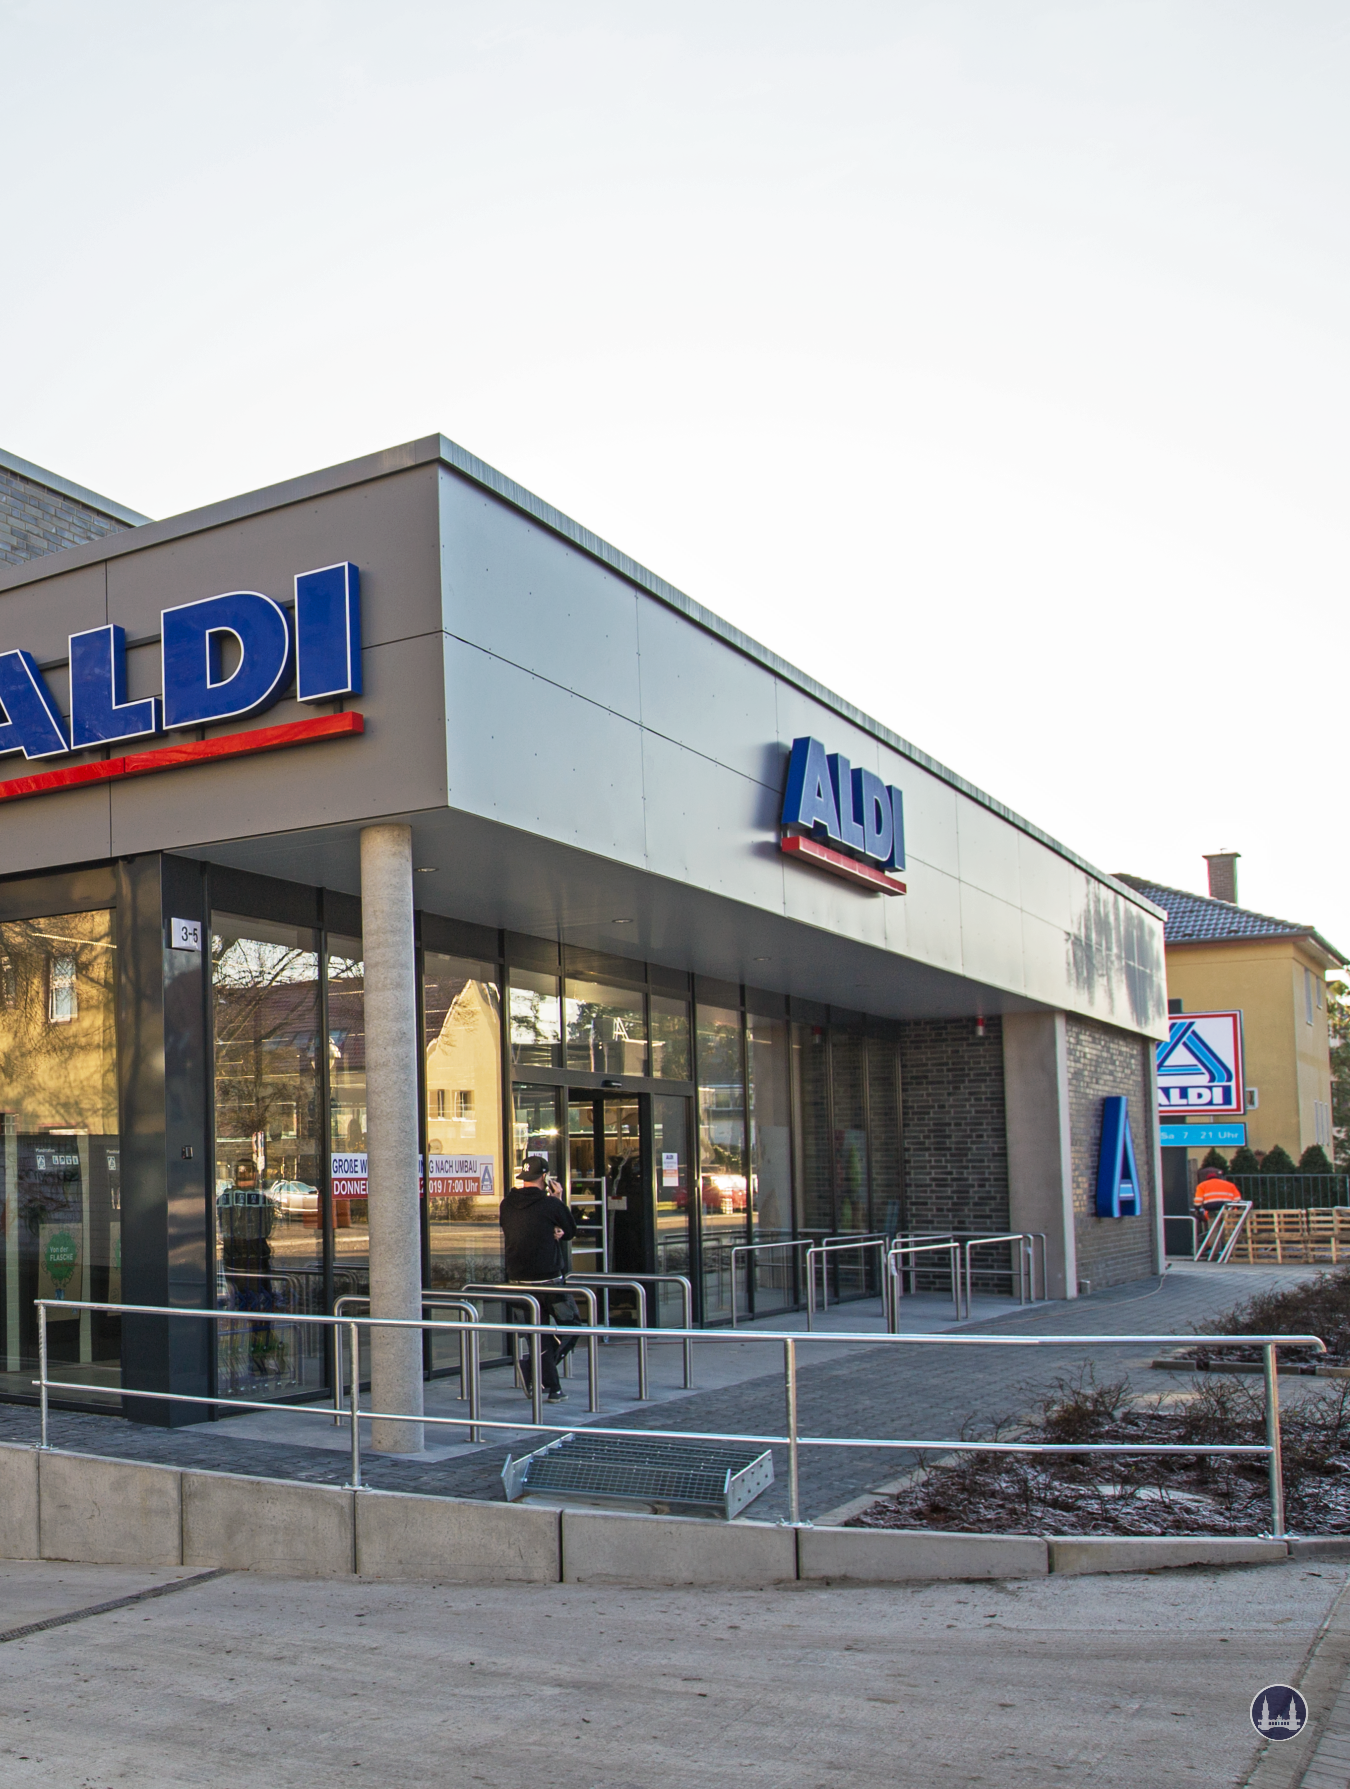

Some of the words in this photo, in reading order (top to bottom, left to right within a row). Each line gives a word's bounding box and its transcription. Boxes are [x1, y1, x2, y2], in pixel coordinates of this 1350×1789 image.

[782, 736, 906, 873] ALDI
[181, 926, 199, 943] 3-5
[1183, 1131, 1189, 1139] 7
[1200, 1131, 1213, 1139] 21
[1218, 1131, 1239, 1139] Uhr
[435, 1160, 453, 1174] NACH
[454, 1160, 478, 1174] UMBAU
[448, 1180, 464, 1193] 7:00
[465, 1179, 478, 1192] Uhr
